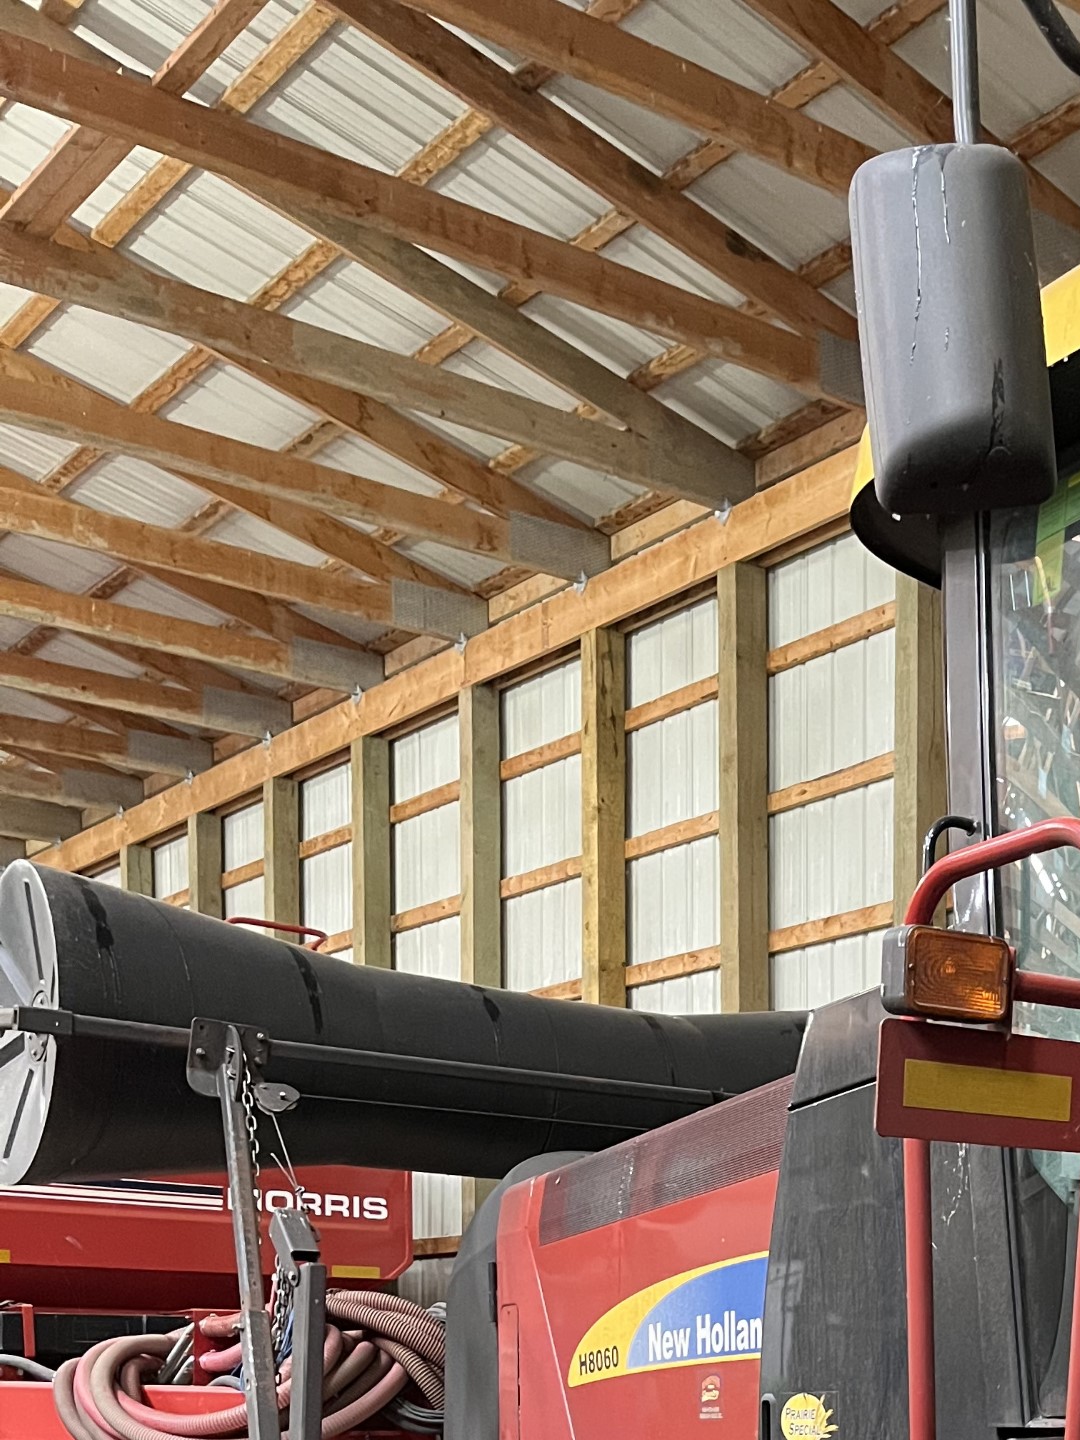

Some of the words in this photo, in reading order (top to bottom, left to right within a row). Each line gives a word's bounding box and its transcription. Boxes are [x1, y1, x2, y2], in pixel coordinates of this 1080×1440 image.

[648, 1322, 691, 1362] New
[696, 1310, 762, 1355] Hollan
[578, 1345, 619, 1376] H8060
